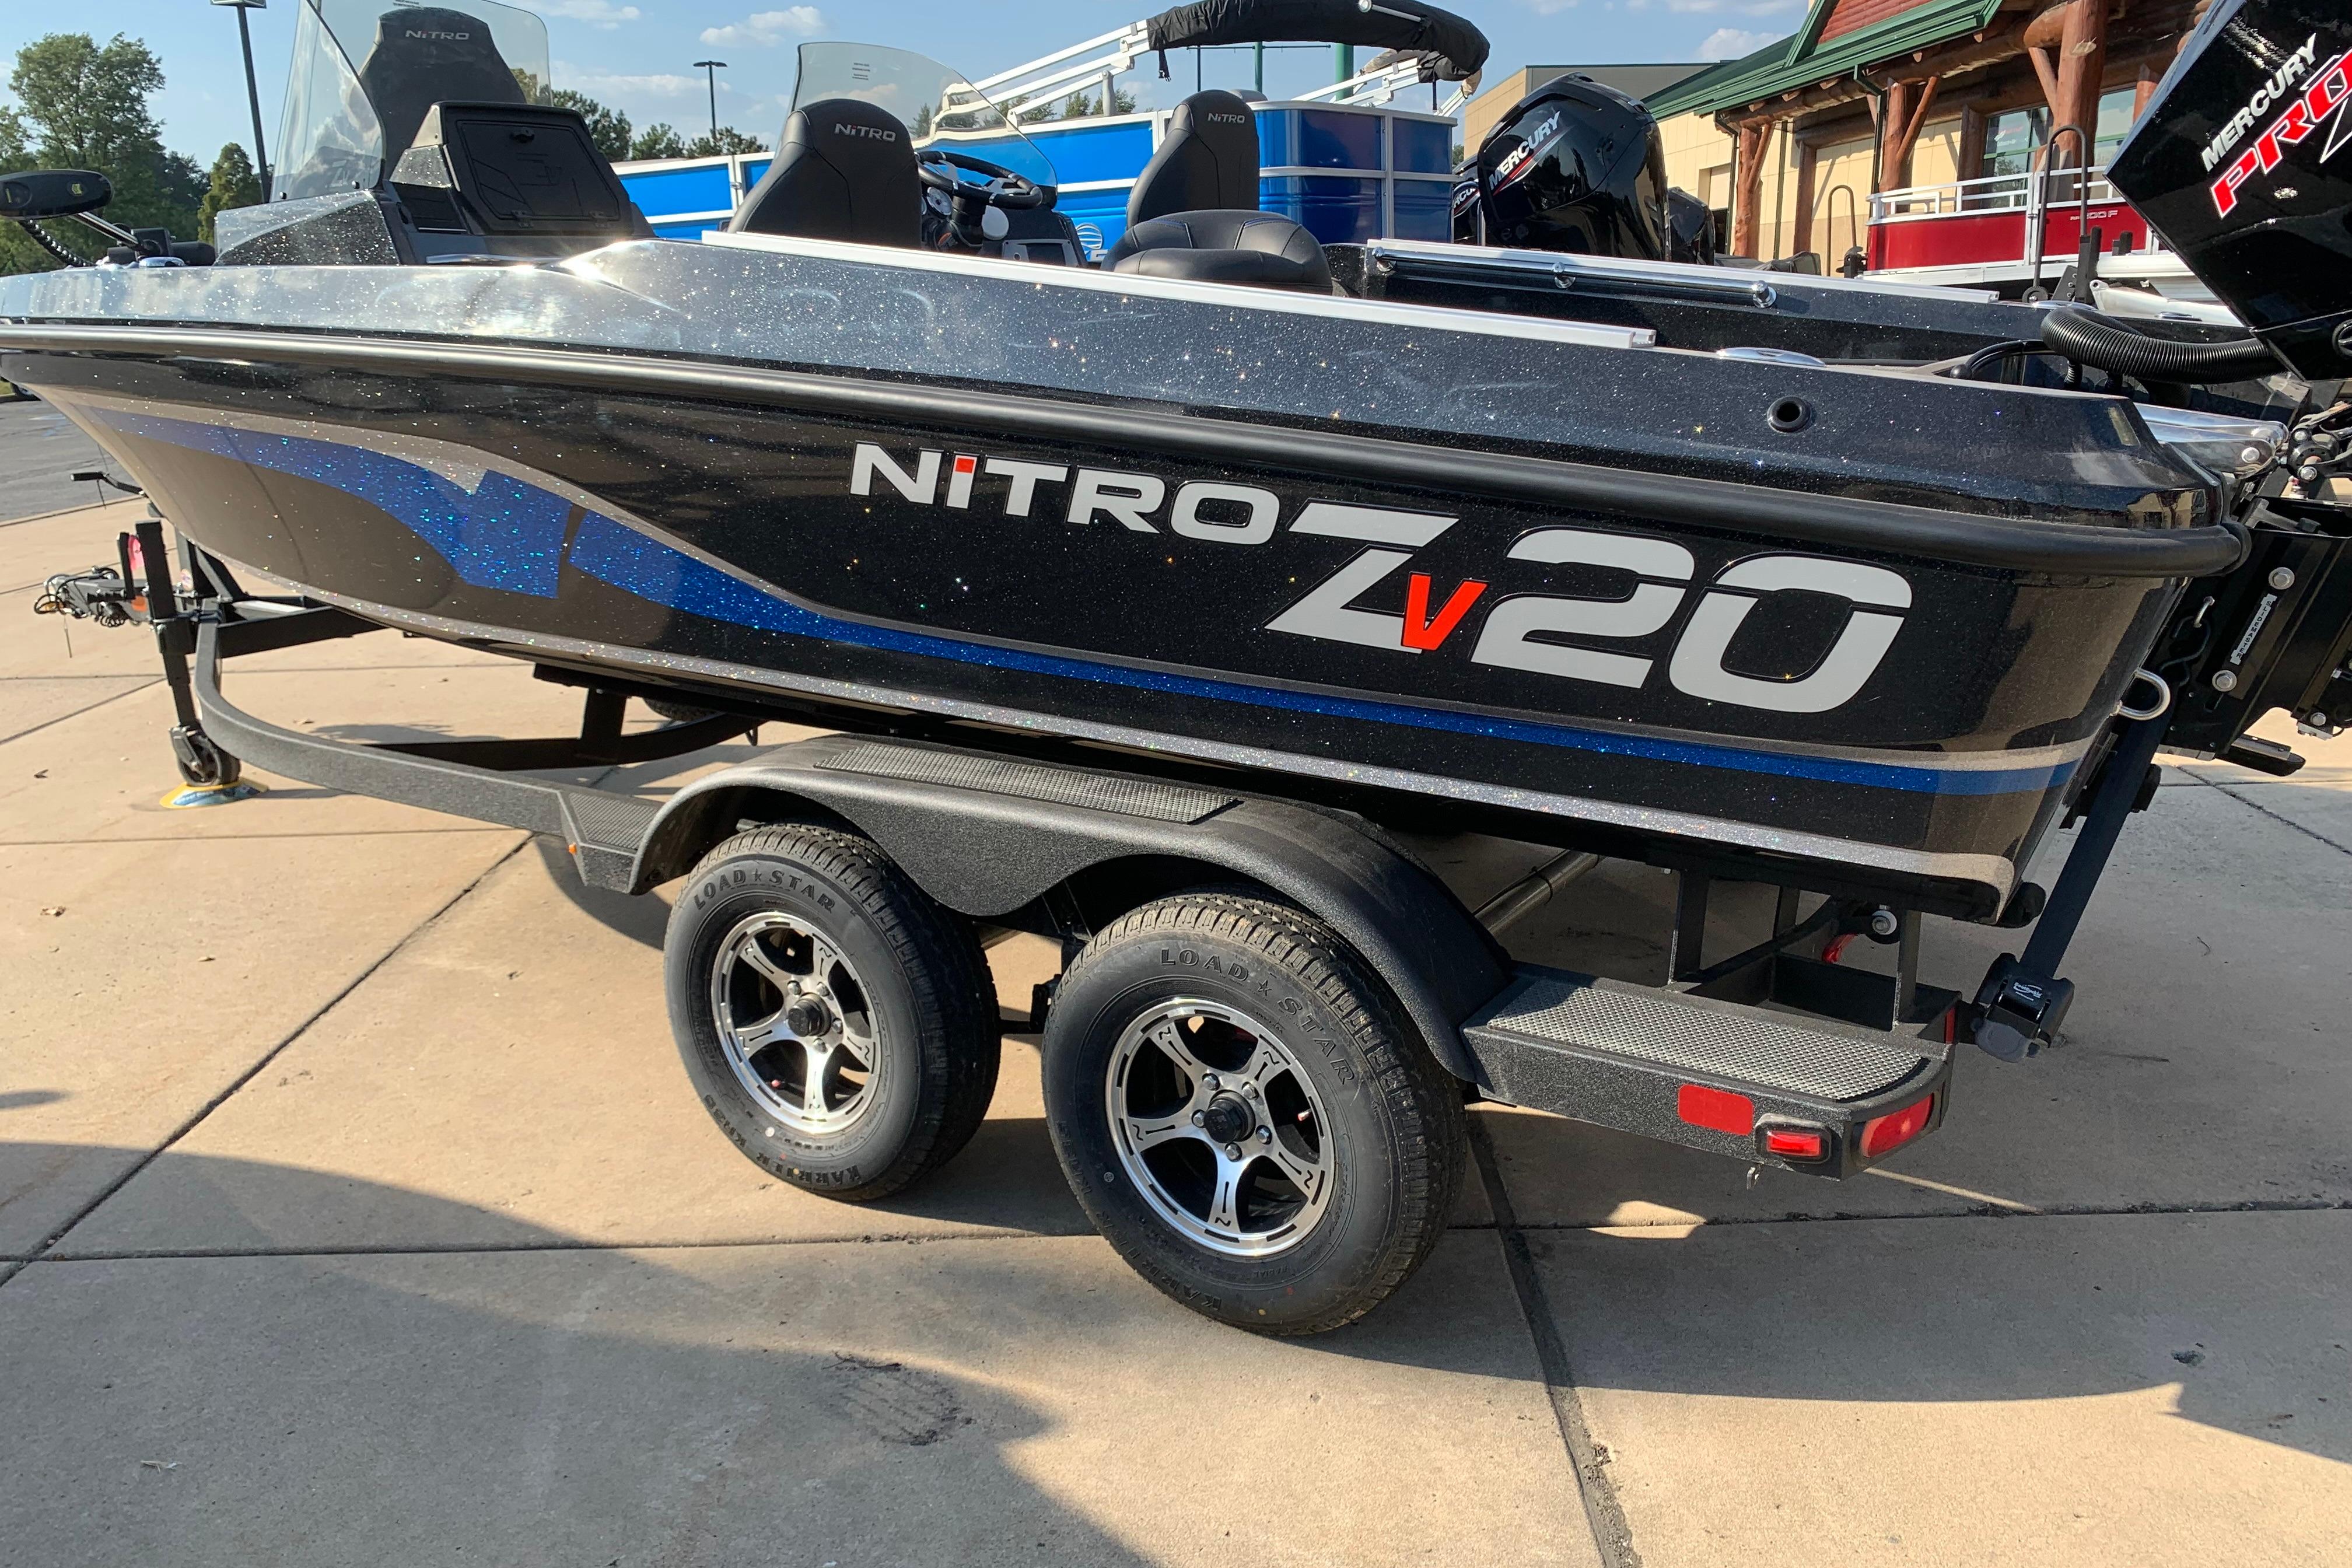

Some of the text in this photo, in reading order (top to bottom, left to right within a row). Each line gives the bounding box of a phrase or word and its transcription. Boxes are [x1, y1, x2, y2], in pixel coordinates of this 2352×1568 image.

[2201, 32, 2316, 172] MERCURY
[2210, 46, 2352, 219] PRO
[1489, 111, 1560, 191] MERCURY
[2087, 211, 2107, 219] 00
[2236, 601, 2272, 658] SLIDEMASTER
[694, 869, 835, 914] LOAD STAR
[1160, 949, 1355, 1085] LOAD STAR
